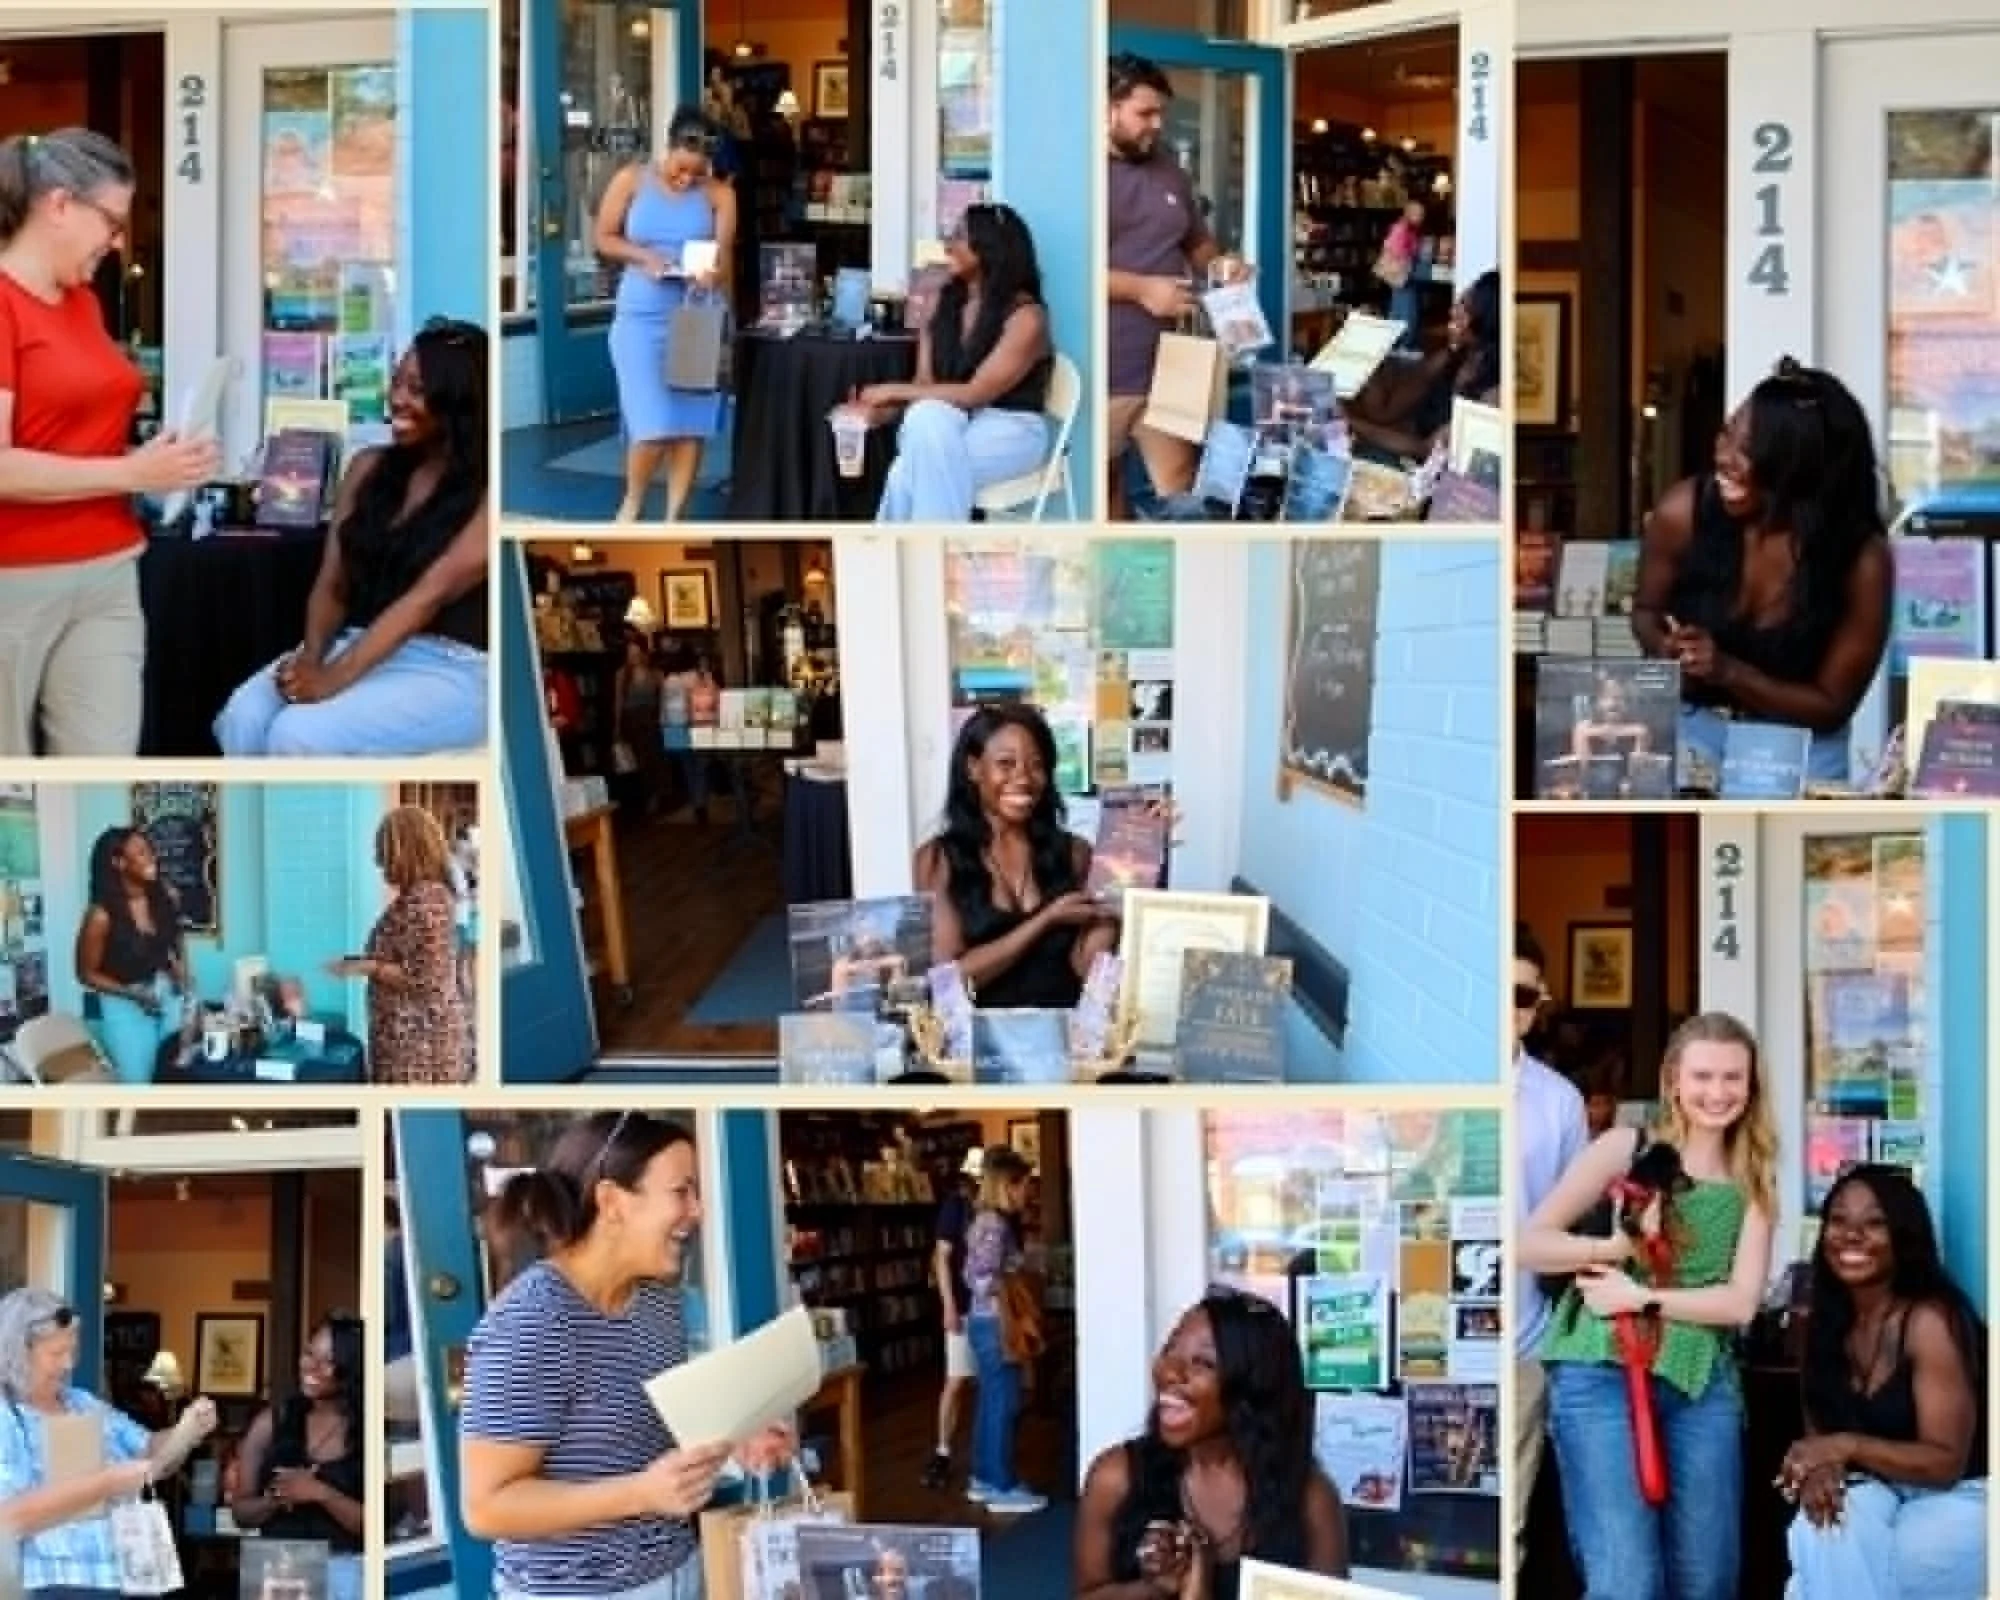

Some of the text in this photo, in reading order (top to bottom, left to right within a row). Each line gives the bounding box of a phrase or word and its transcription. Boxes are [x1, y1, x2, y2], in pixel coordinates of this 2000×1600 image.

[880, 4, 898, 81] 214
[1467, 51, 1489, 141] 214
[178, 74, 205, 185] 214
[1747, 121, 1793, 295] 214
[1713, 841, 1743, 961] 214
